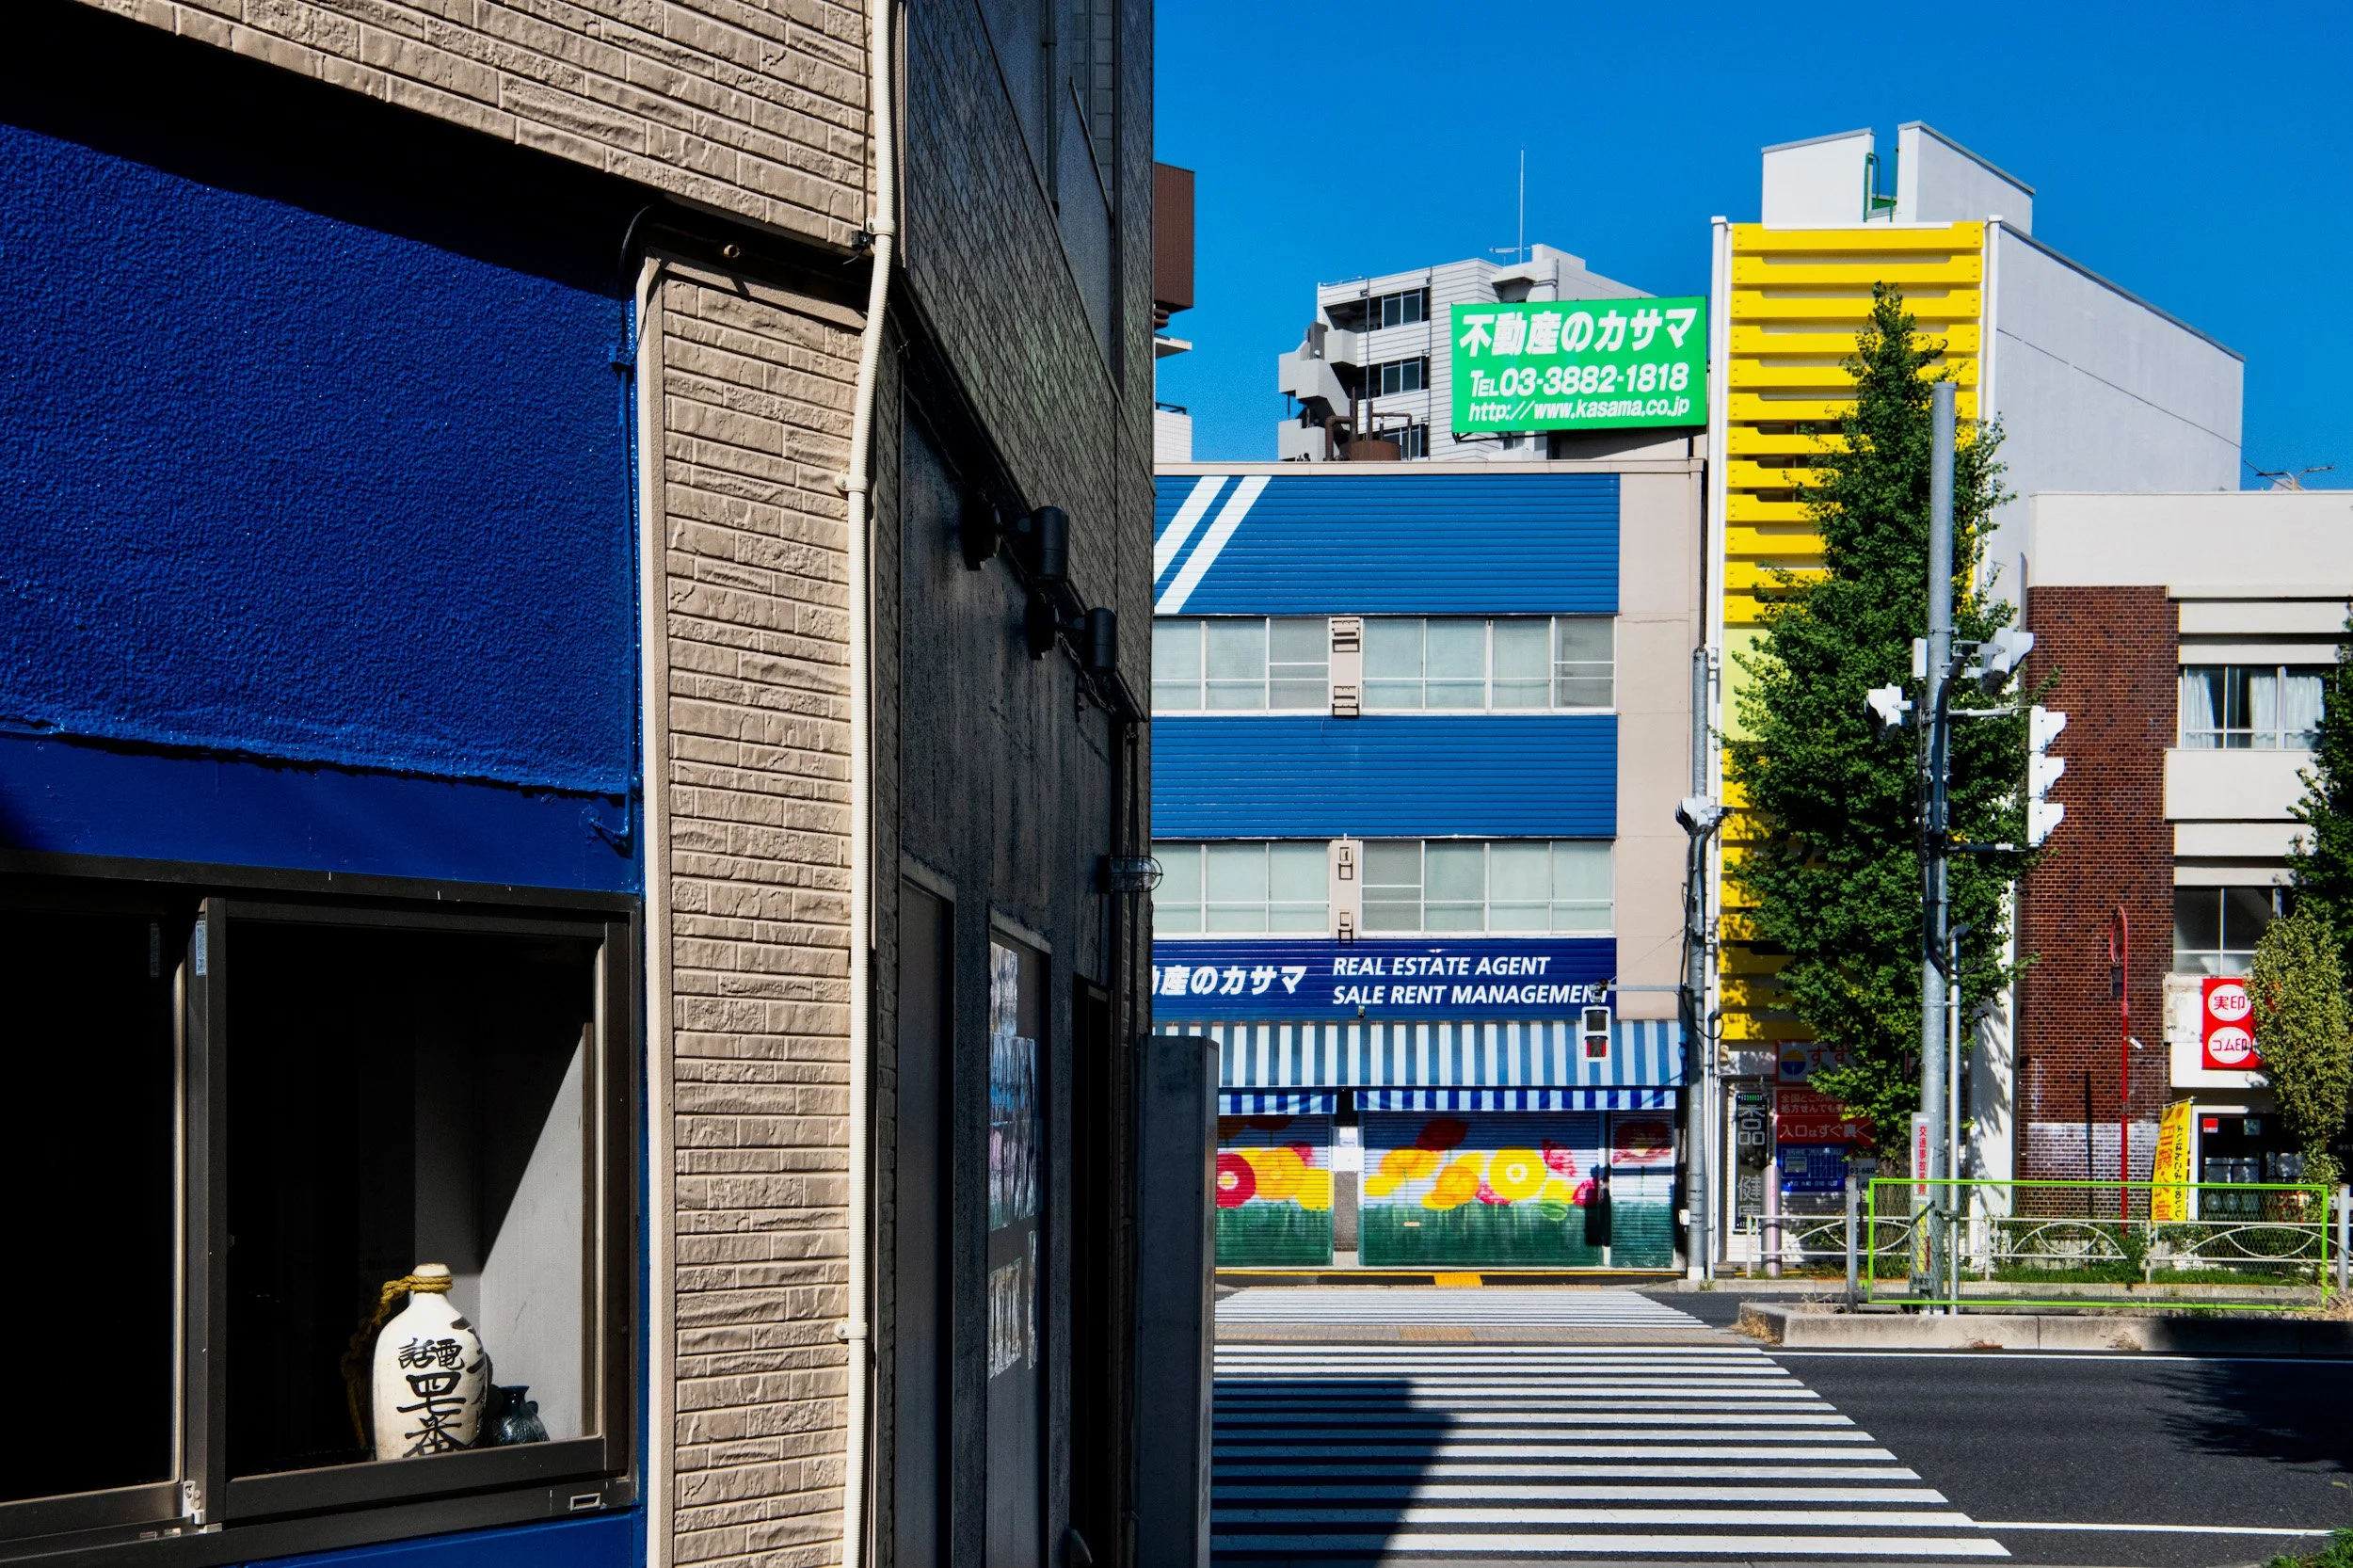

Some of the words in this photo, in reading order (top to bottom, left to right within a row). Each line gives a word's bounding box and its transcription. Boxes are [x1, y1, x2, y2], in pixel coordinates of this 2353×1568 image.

[1459, 309, 1697, 358] 不動産のカサマ
[1468, 396, 1690, 423] http://www.kasama.co.jp
[1333, 956, 1386, 976] REAL
[1392, 956, 1471, 976] ESTATE
[1474, 956, 1551, 976] AGENT
[1152, 965, 1307, 996] 産のカサマ
[1333, 984, 1385, 1004] SALE
[1391, 984, 1449, 1004] RENT
[2214, 996, 2246, 1010] 実印
[2212, 1038, 2248, 1052] ゴム印
